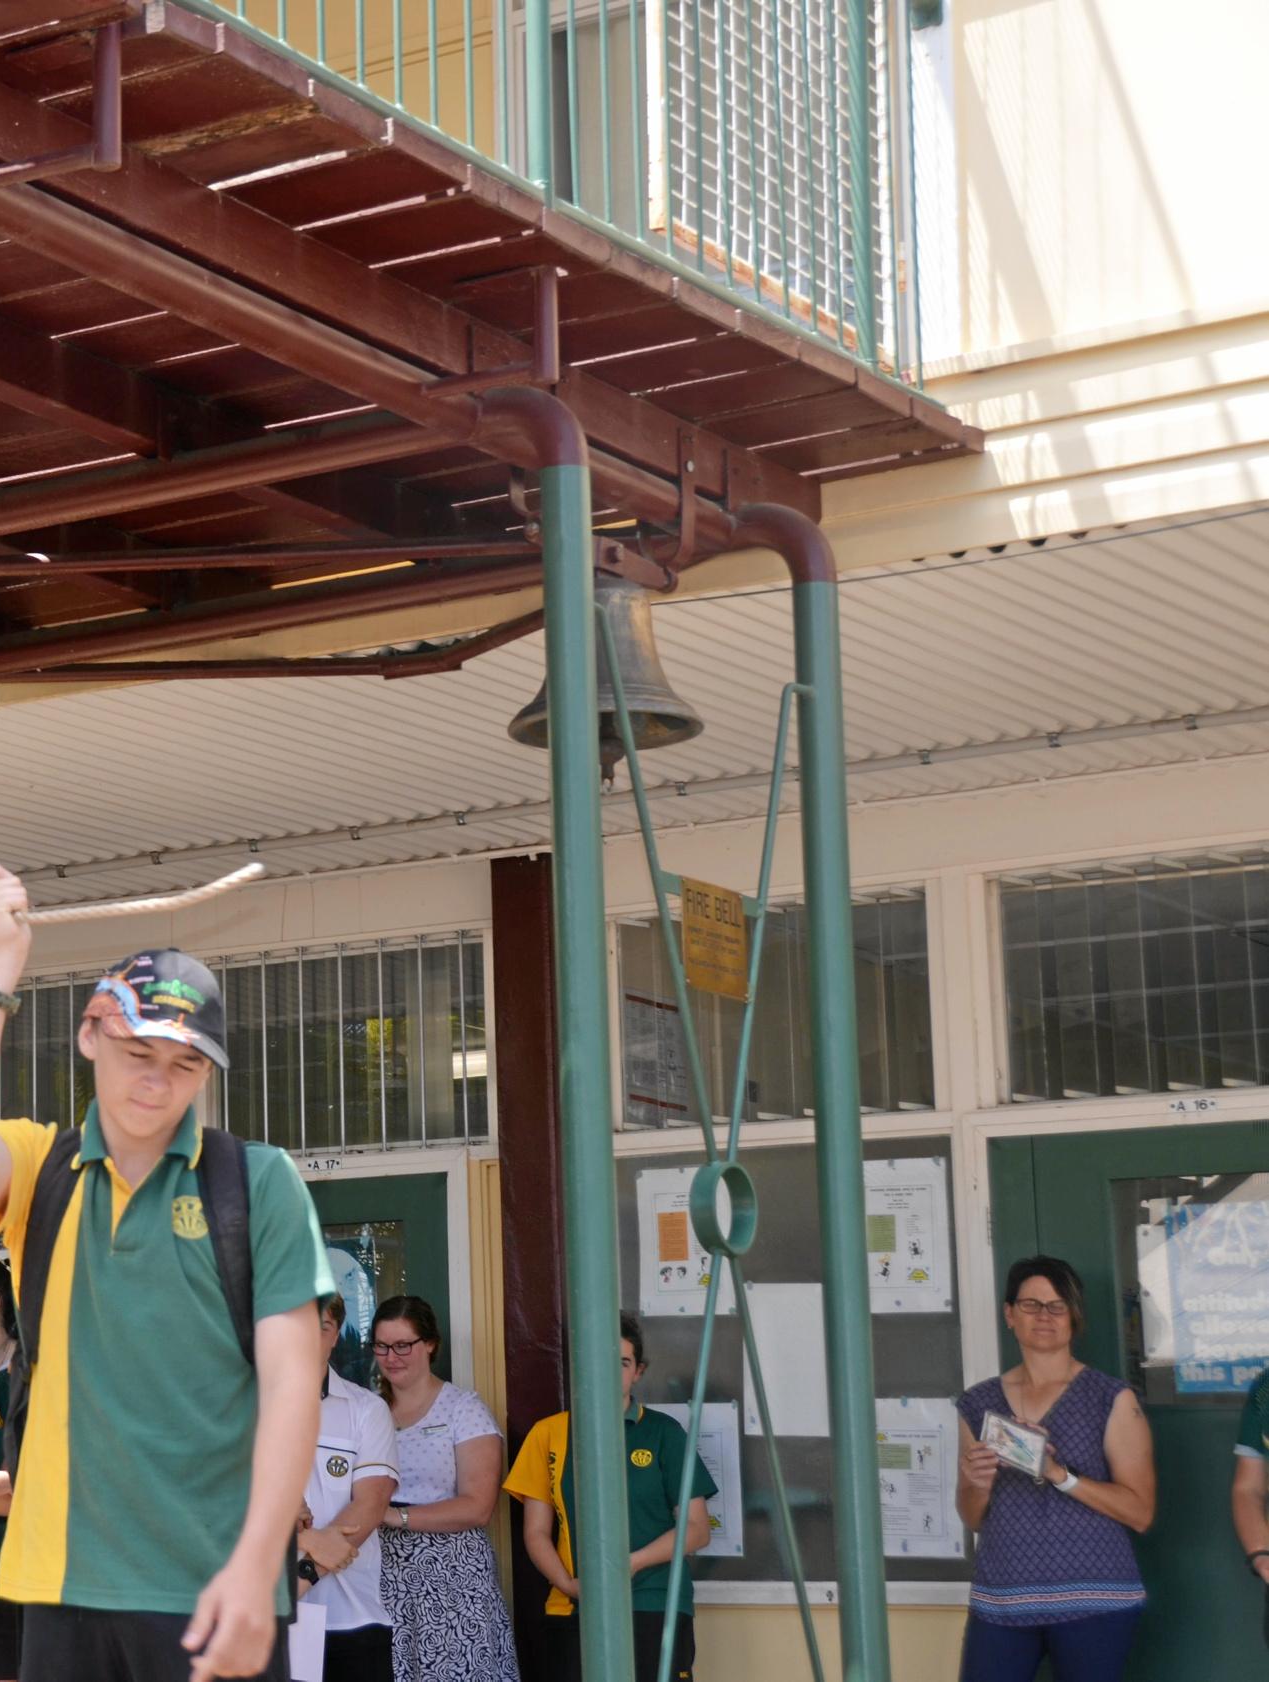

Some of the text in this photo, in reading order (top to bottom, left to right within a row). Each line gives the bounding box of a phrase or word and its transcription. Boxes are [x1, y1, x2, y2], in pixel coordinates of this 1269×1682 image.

[686, 888, 741, 928] FIRE BELL
[1176, 1099, 1209, 1111] A 16
[313, 1159, 335, 1170] A 17
[1181, 1361, 1226, 1381] this
